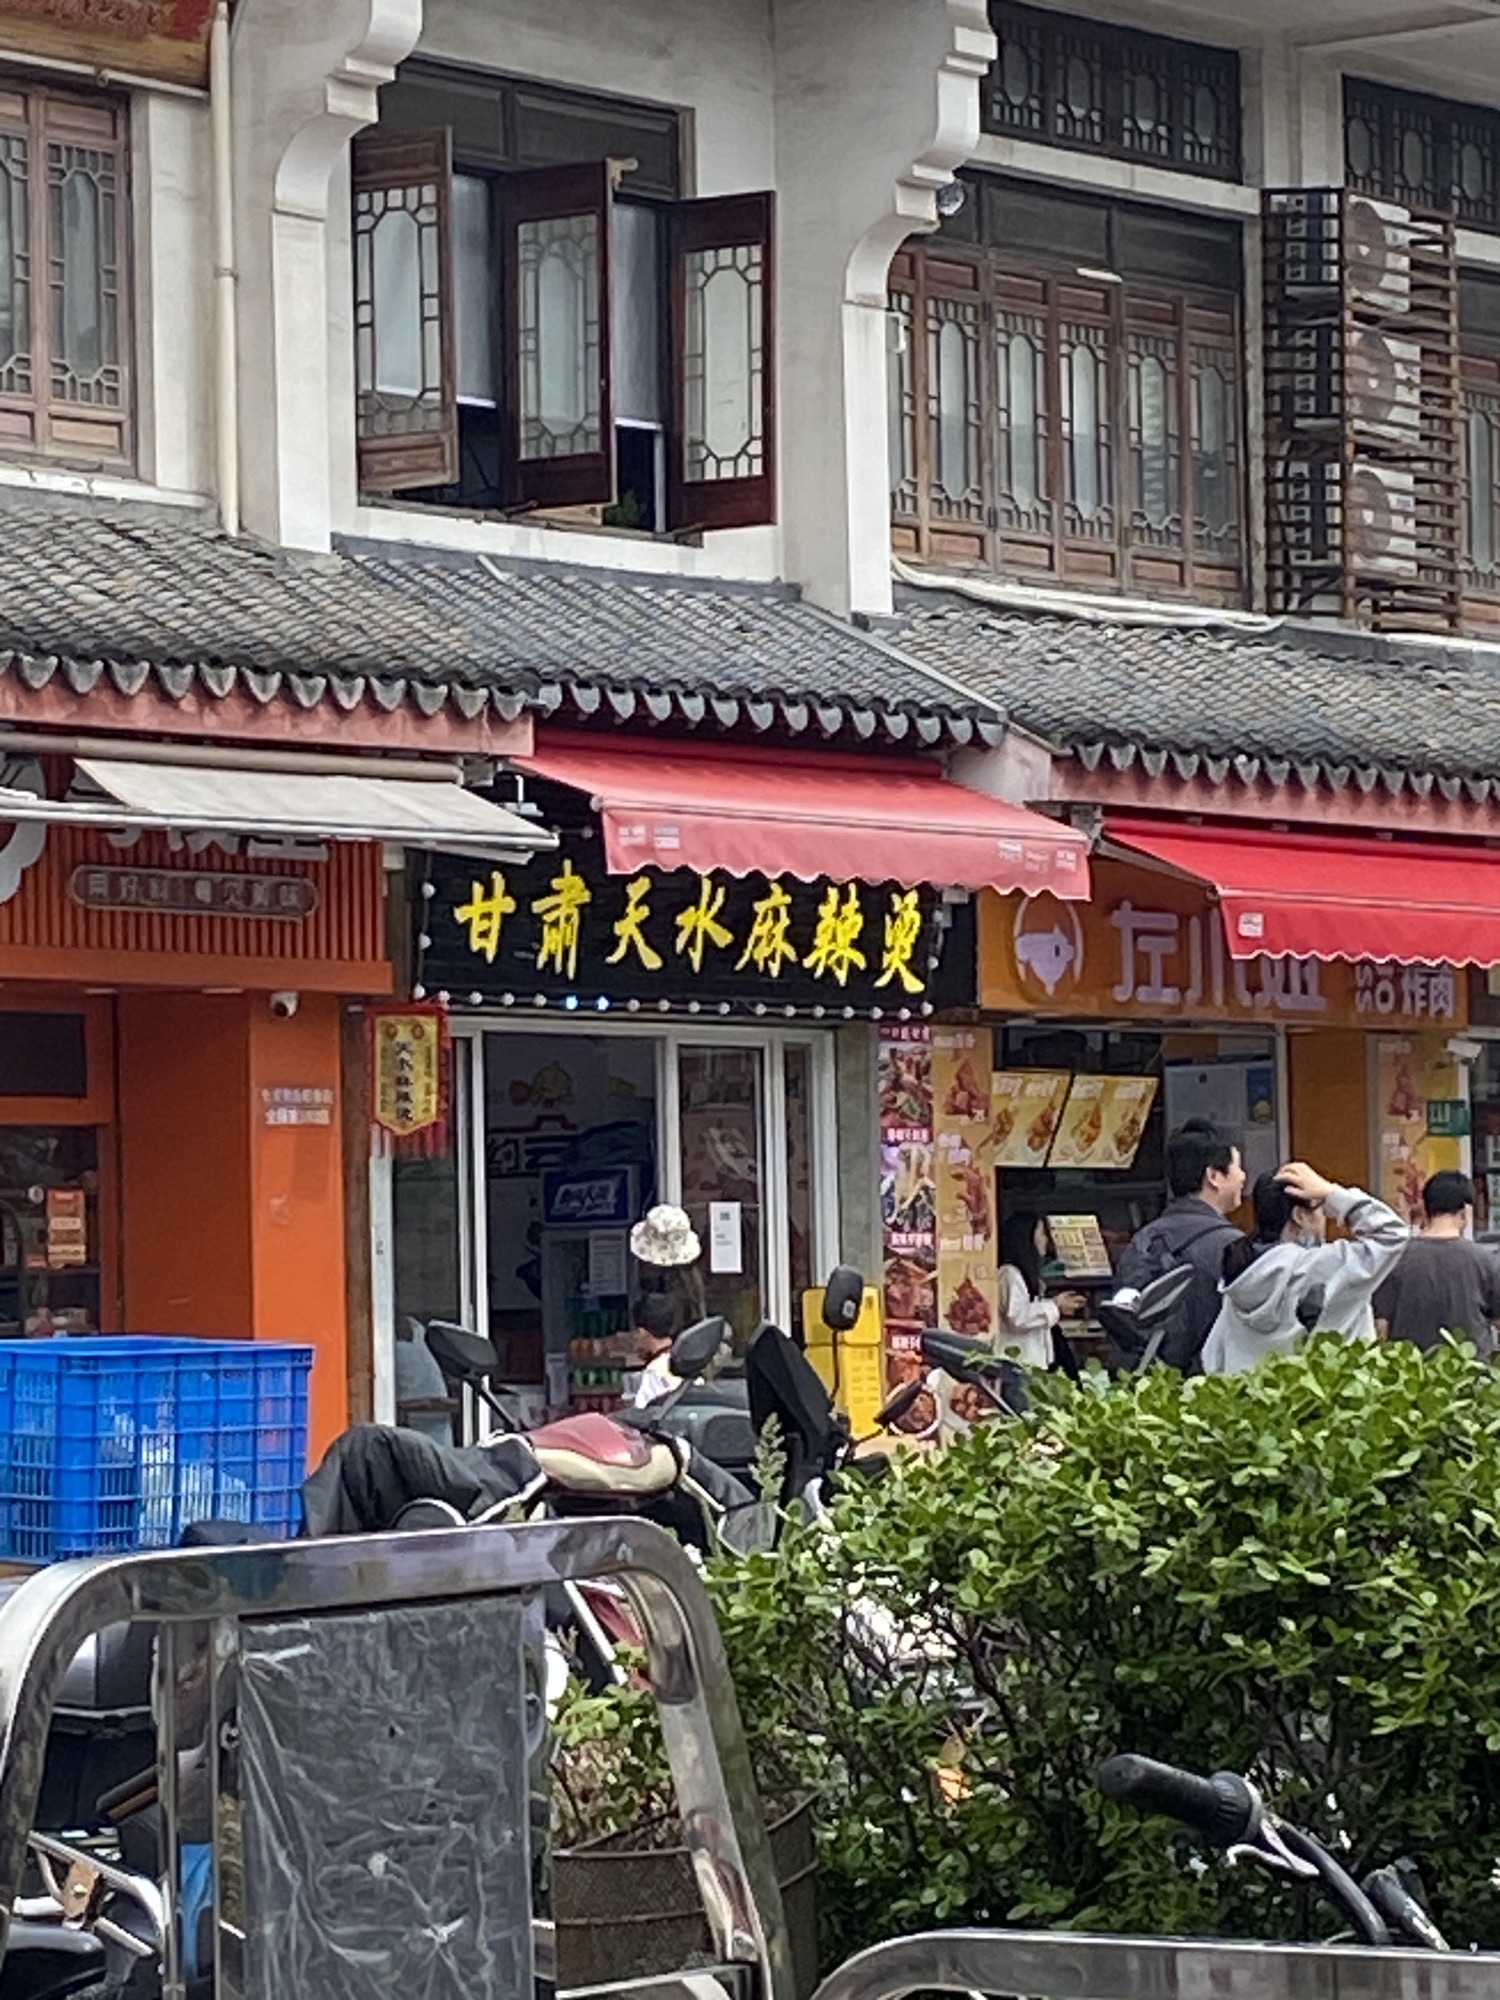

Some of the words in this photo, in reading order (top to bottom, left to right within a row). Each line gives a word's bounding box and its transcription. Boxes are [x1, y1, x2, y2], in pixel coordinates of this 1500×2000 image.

[453, 858, 926, 994] 甘肃天水麻辣烫
